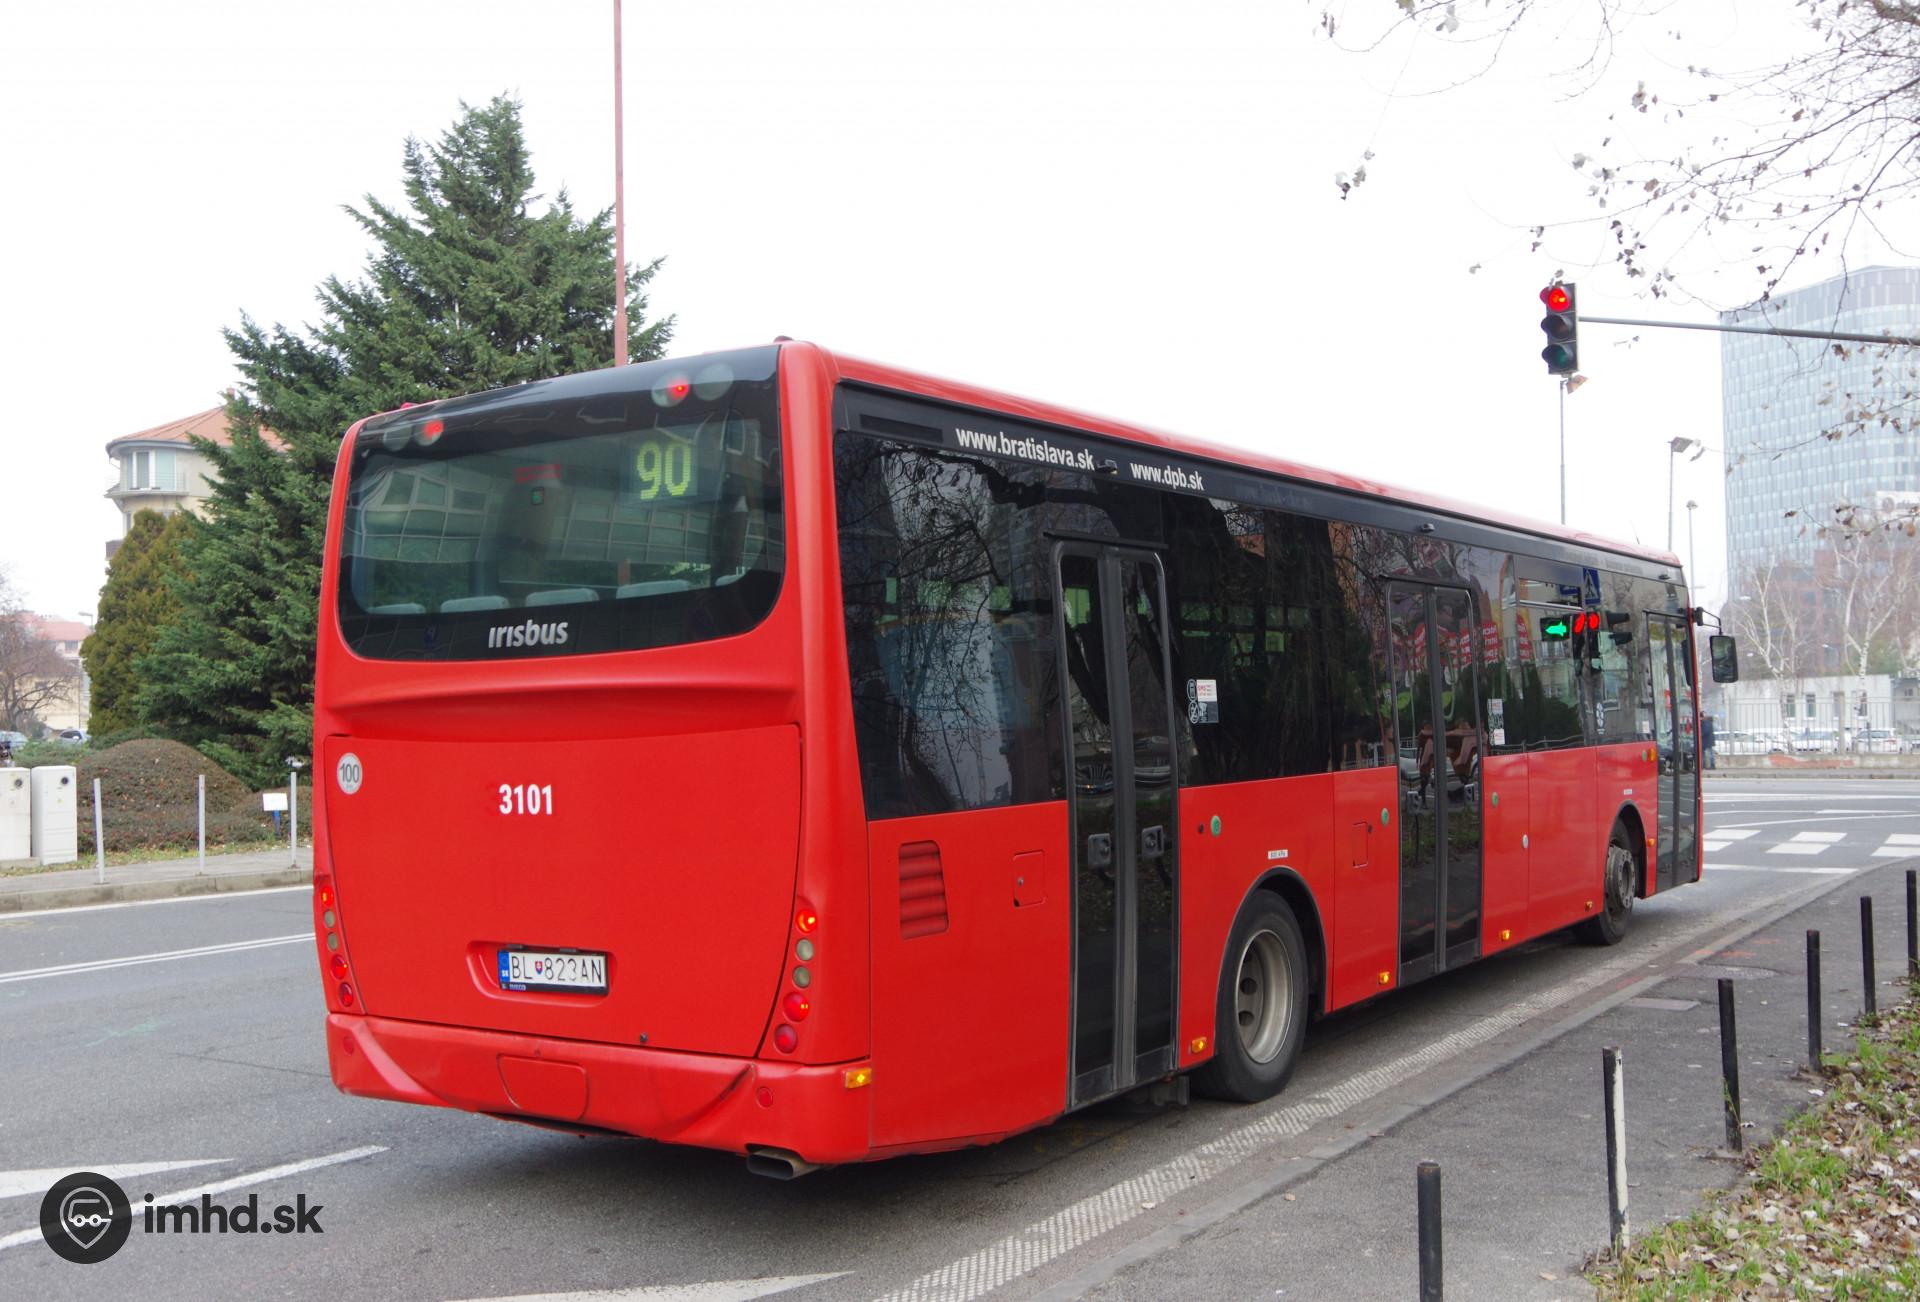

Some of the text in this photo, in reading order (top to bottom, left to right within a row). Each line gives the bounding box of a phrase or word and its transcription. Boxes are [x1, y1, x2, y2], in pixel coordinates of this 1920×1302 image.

[956, 428, 1095, 471] www.bratislava.sk
[636, 441, 692, 500] 90
[1130, 462, 1204, 491] www.dpb.sk
[488, 619, 568, 648] irisbus
[340, 763, 360, 783] 100
[499, 783, 552, 815] 3101
[511, 955, 532, 980] BL
